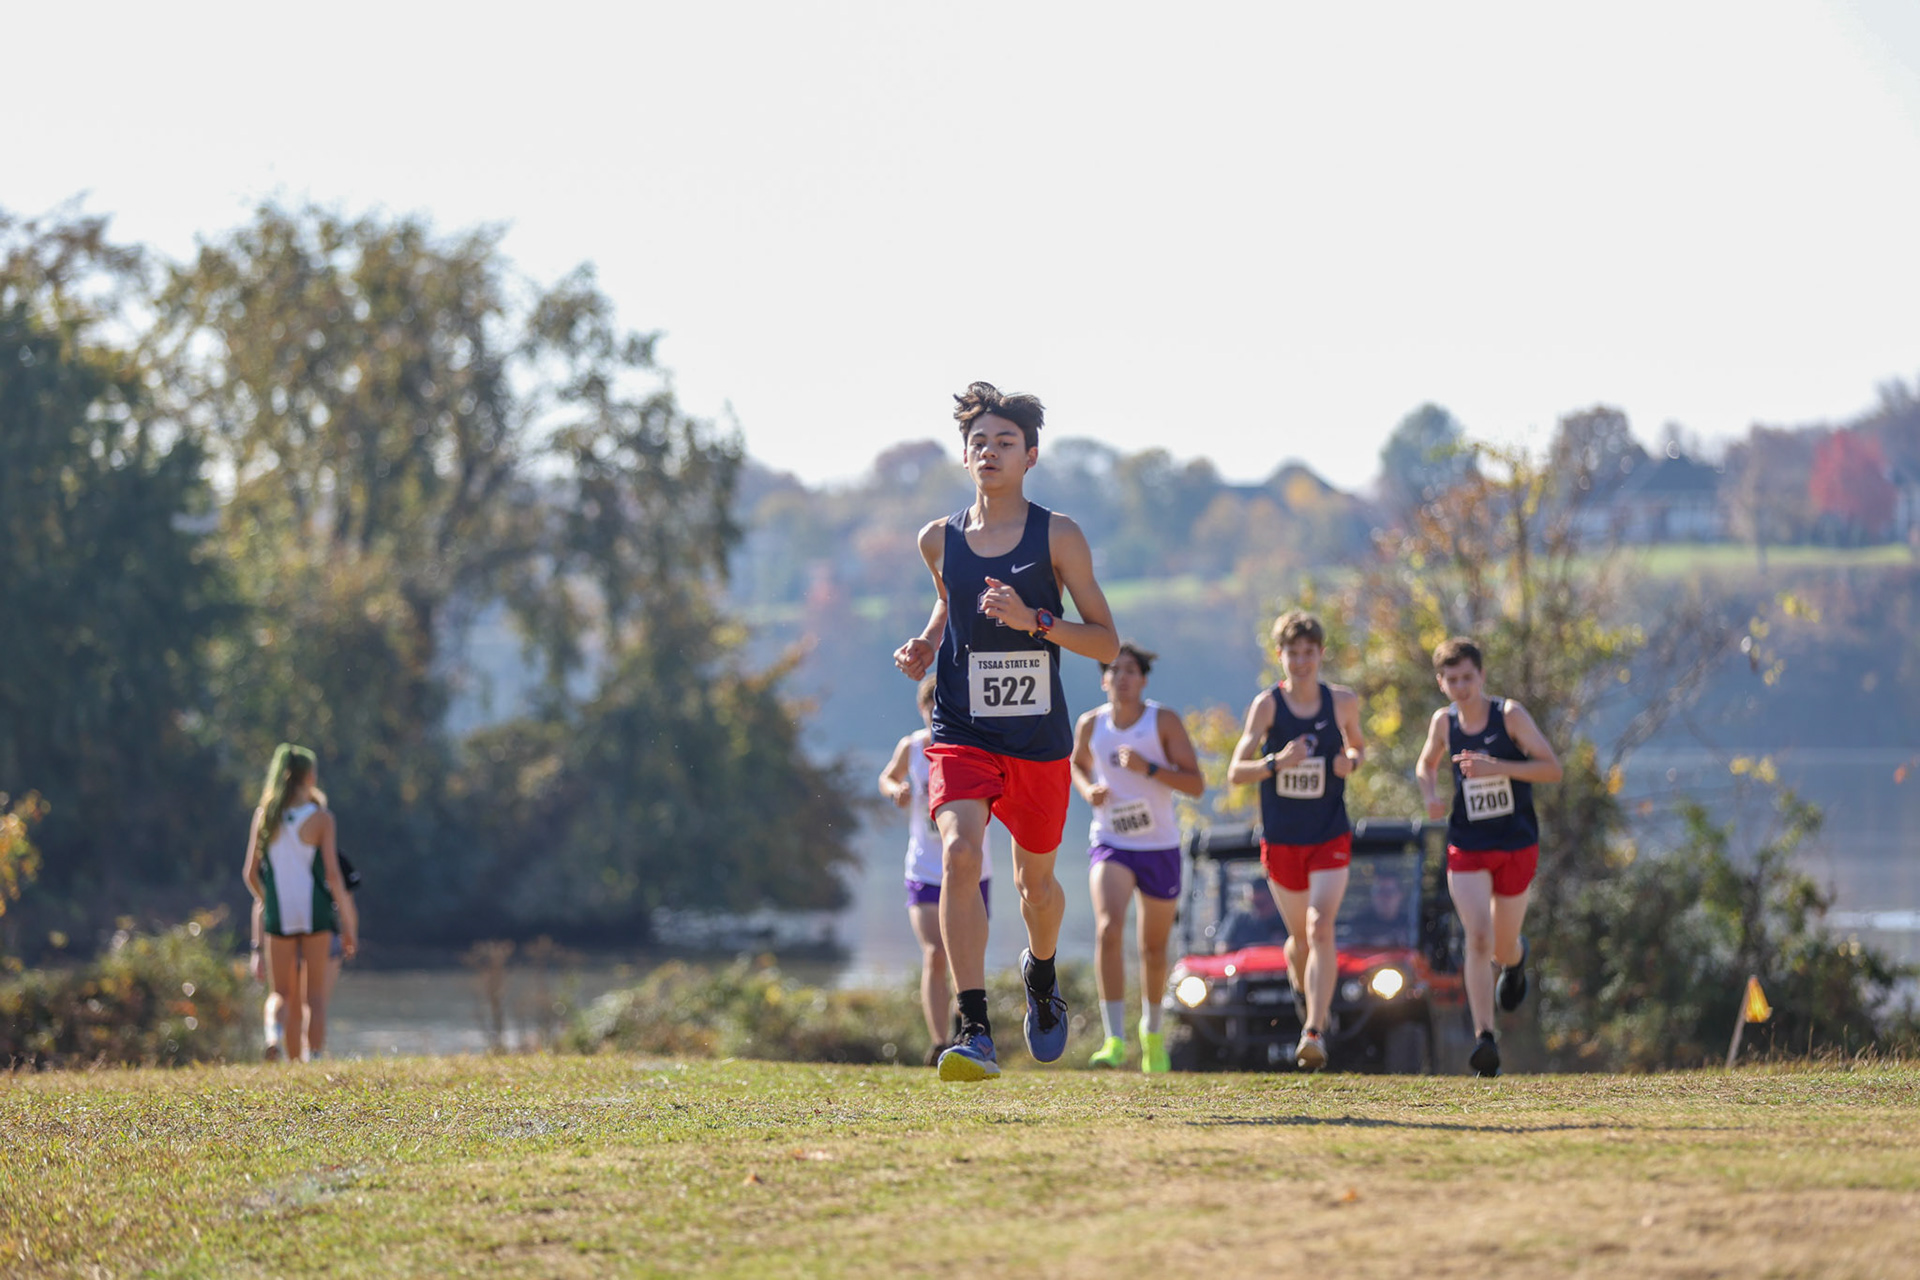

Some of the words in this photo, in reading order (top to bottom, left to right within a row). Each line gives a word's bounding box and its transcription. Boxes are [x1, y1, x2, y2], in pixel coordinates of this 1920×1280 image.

[978, 660, 1003, 670] TSSAA
[1004, 659, 1028, 669] STATE
[1029, 658, 1040, 668] XC
[983, 675, 1036, 707] 522
[1283, 772, 1321, 791] 1199
[1469, 789, 1509, 813] 1200
